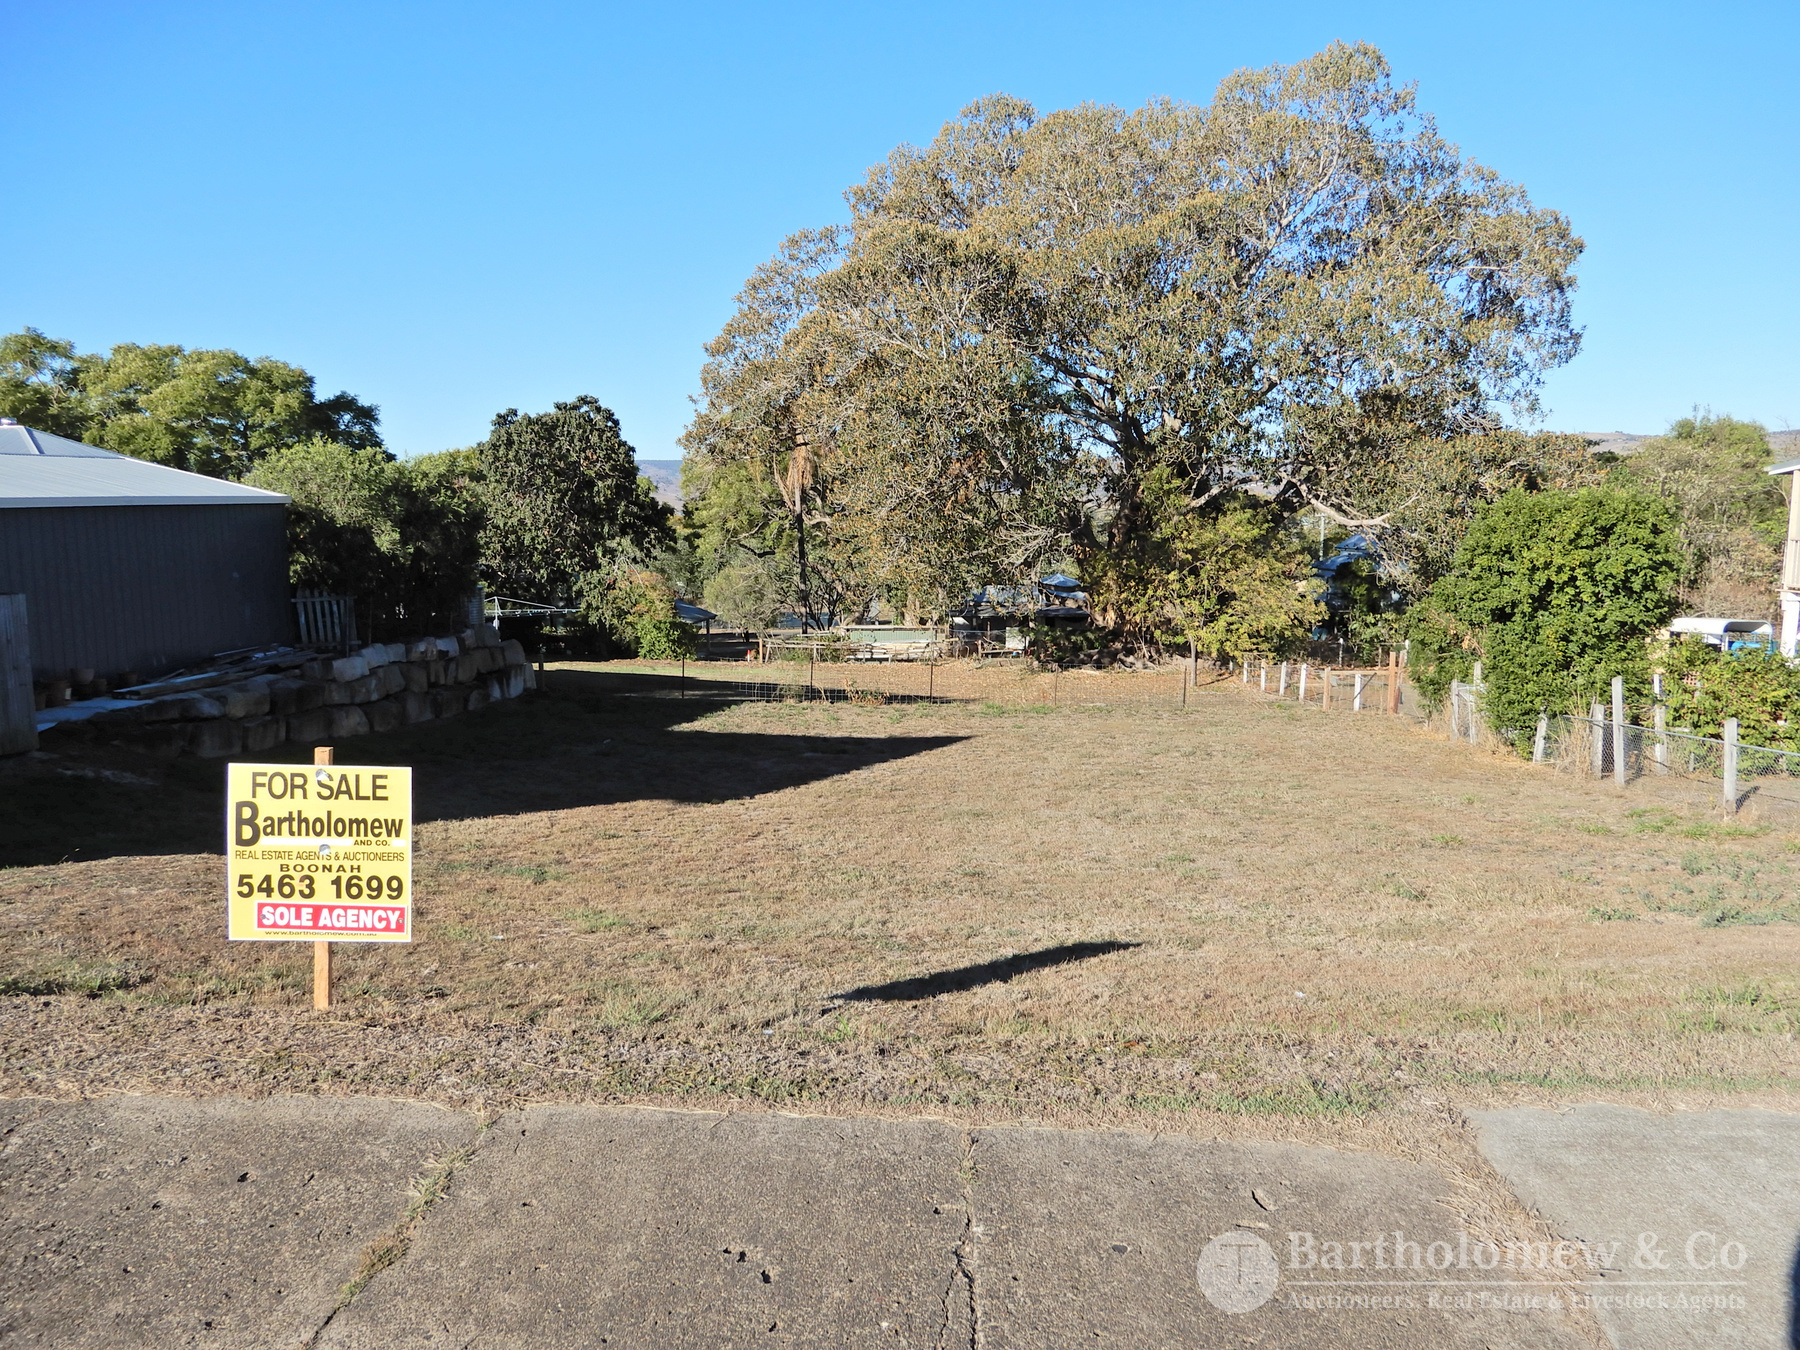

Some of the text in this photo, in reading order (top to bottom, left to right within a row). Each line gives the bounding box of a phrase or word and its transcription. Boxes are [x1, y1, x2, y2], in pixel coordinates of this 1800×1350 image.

[251, 771, 389, 801] FOR SALE
[235, 800, 404, 847] Bartholomew
[353, 839, 391, 847] AND CO.
[235, 850, 260, 860] REAL
[261, 850, 294, 861] ESTATE
[333, 851, 340, 861] &
[342, 851, 405, 862] AUCTIONEERS
[279, 863, 362, 873] BOONAH
[236, 874, 404, 900] 5463 1699
[261, 905, 401, 930] SOLE AGENCY
